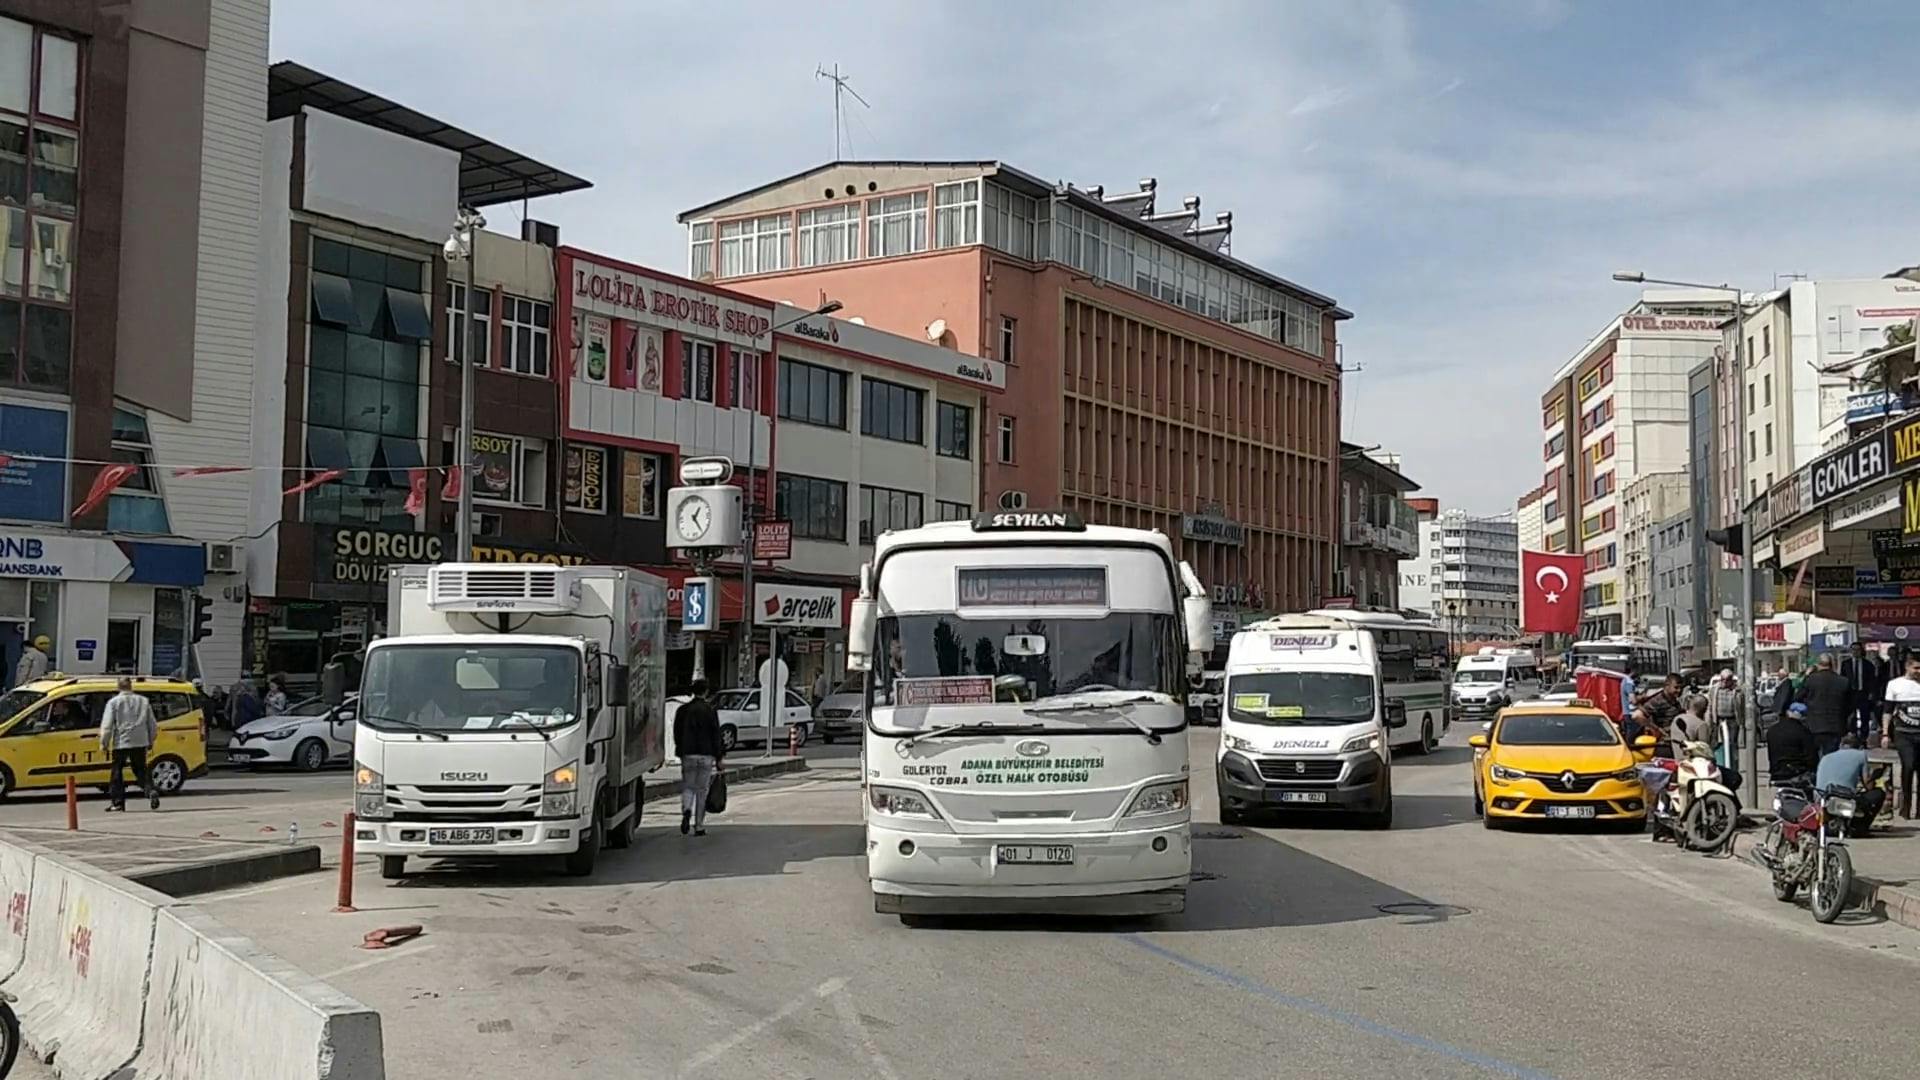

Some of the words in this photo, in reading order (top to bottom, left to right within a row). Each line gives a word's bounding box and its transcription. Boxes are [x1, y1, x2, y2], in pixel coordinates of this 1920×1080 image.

[575, 269, 647, 313] LOLİTA
[651, 290, 720, 328] EROTİK
[723, 308, 770, 340] SHOP
[472, 436, 511, 453] RSOY
[1815, 440, 1882, 497] GÖKLER
[586, 451, 600, 509] ERSOY
[991, 513, 1067, 527] SEYHAN
[336, 557, 389, 582] DÖVİZ
[782, 595, 836, 622] arçelik
[59, 752, 76, 764] 01
[84, 751, 96, 763] T
[960, 760, 994, 770] ADANA
[995, 757, 1053, 772] BÜYÜKŞEHİR
[1054, 756, 1105, 769] BELEDİYESİ
[440, 772, 488, 781] ISUZU
[929, 777, 969, 785] COBRA
[975, 771, 1003, 784] ÖZEL
[1006, 773, 1035, 783] HALK
[1037, 770, 1090, 783] OTOBÜSÜ
[436, 830, 447, 840] 16
[472, 829, 492, 840] 375
[1006, 847, 1017, 860] 01
[1026, 847, 1032, 860] J
[1046, 847, 1071, 860] 0120
